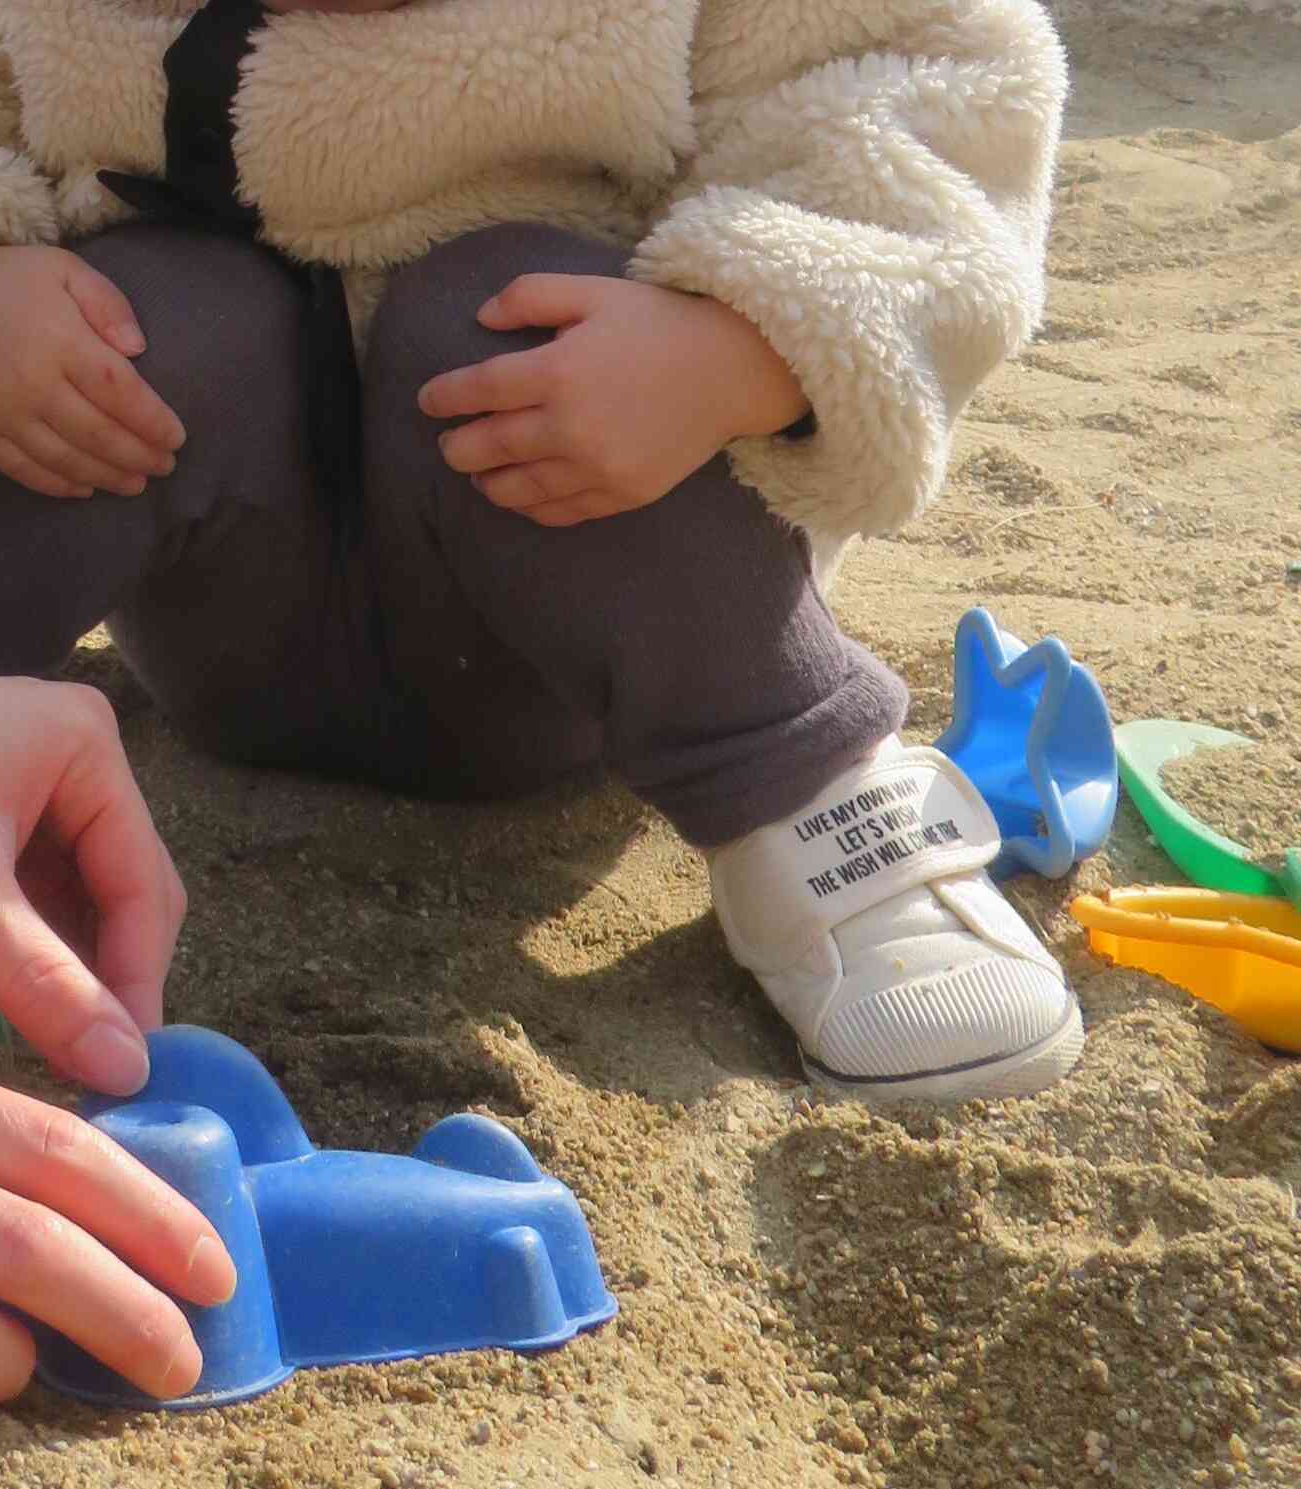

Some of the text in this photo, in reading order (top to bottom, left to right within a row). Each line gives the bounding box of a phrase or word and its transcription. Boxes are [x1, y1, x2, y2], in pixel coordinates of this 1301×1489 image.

[794, 776, 920, 842] LIVE MY OWN WAY
[836, 803, 920, 855] LET'S WISH
[807, 870, 840, 898] THE
[835, 852, 880, 885] WISH
[874, 837, 915, 867] WILL
[907, 826, 943, 850] COME
